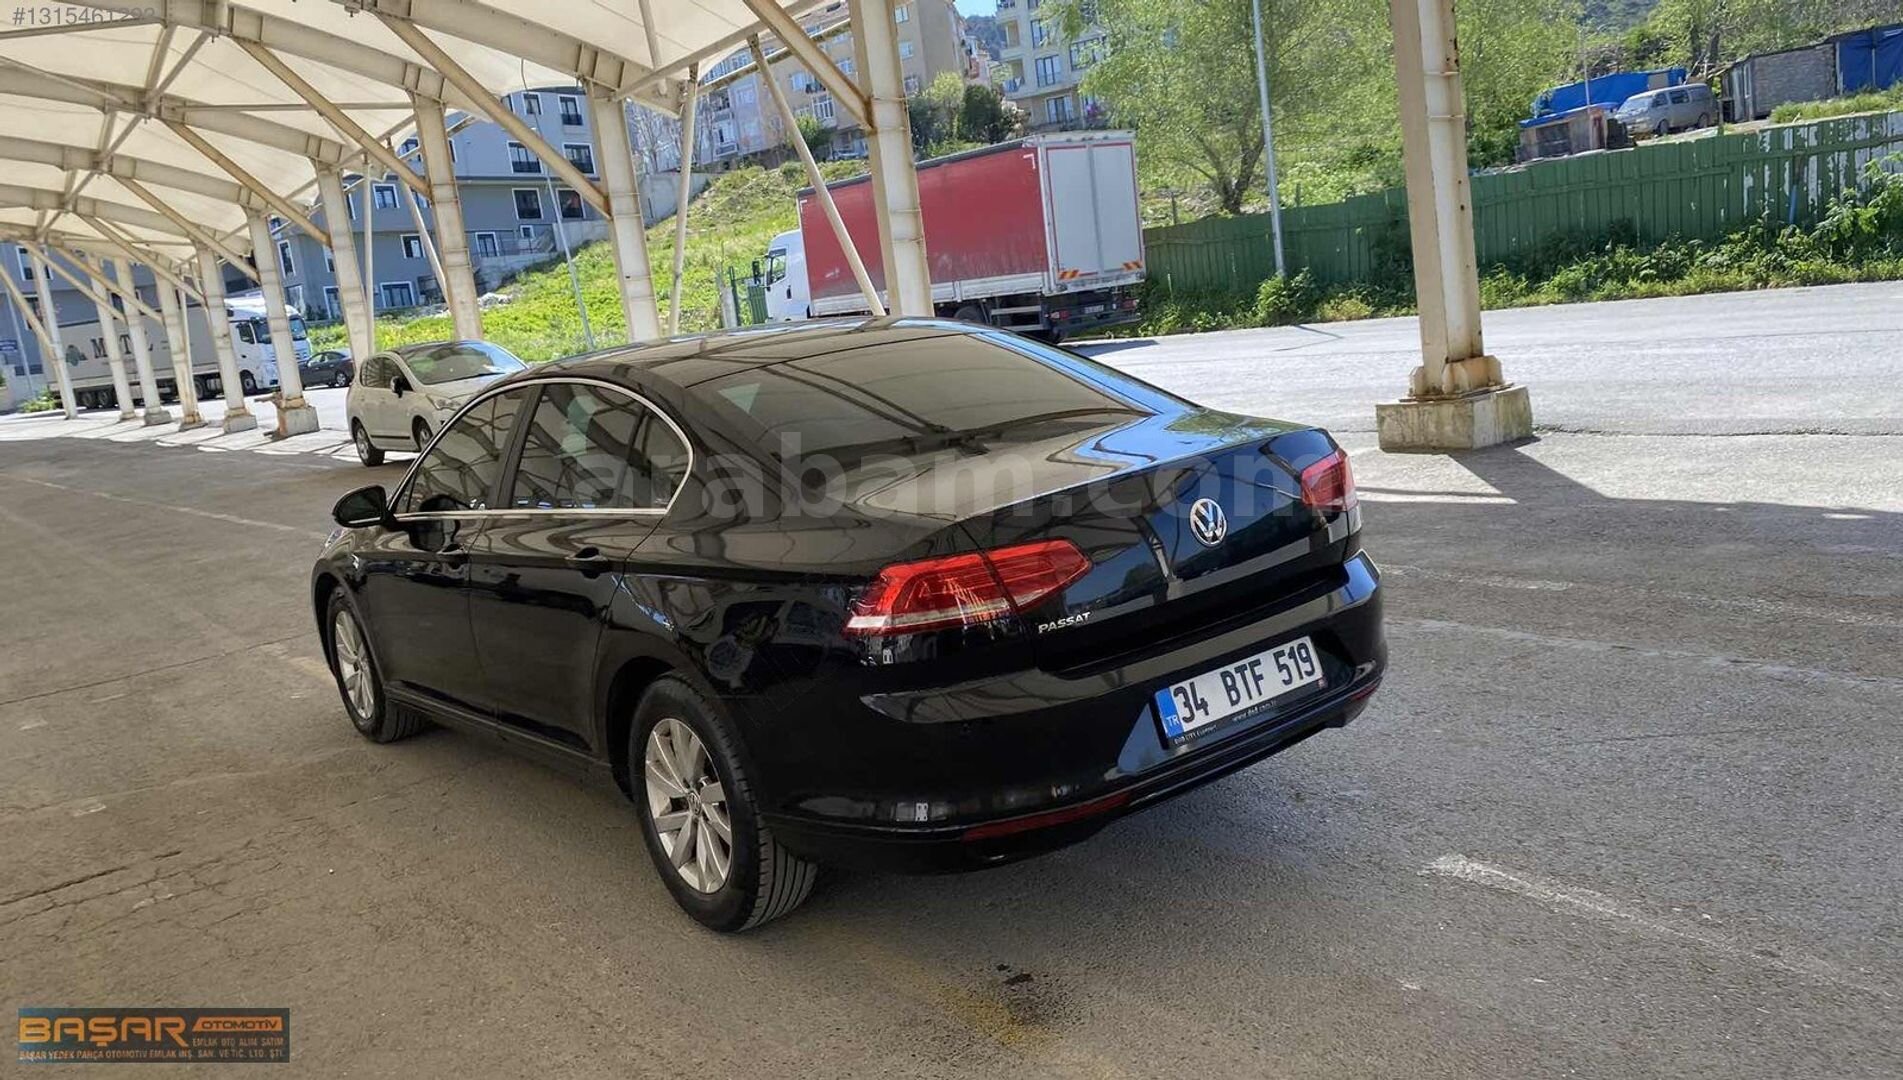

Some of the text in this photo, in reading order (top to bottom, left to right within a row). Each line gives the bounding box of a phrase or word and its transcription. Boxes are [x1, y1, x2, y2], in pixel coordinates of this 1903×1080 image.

[1038, 611, 1091, 634] PASSAT
[1173, 642, 1316, 724] 34 BTF 519
[1165, 714, 1180, 727] TR
